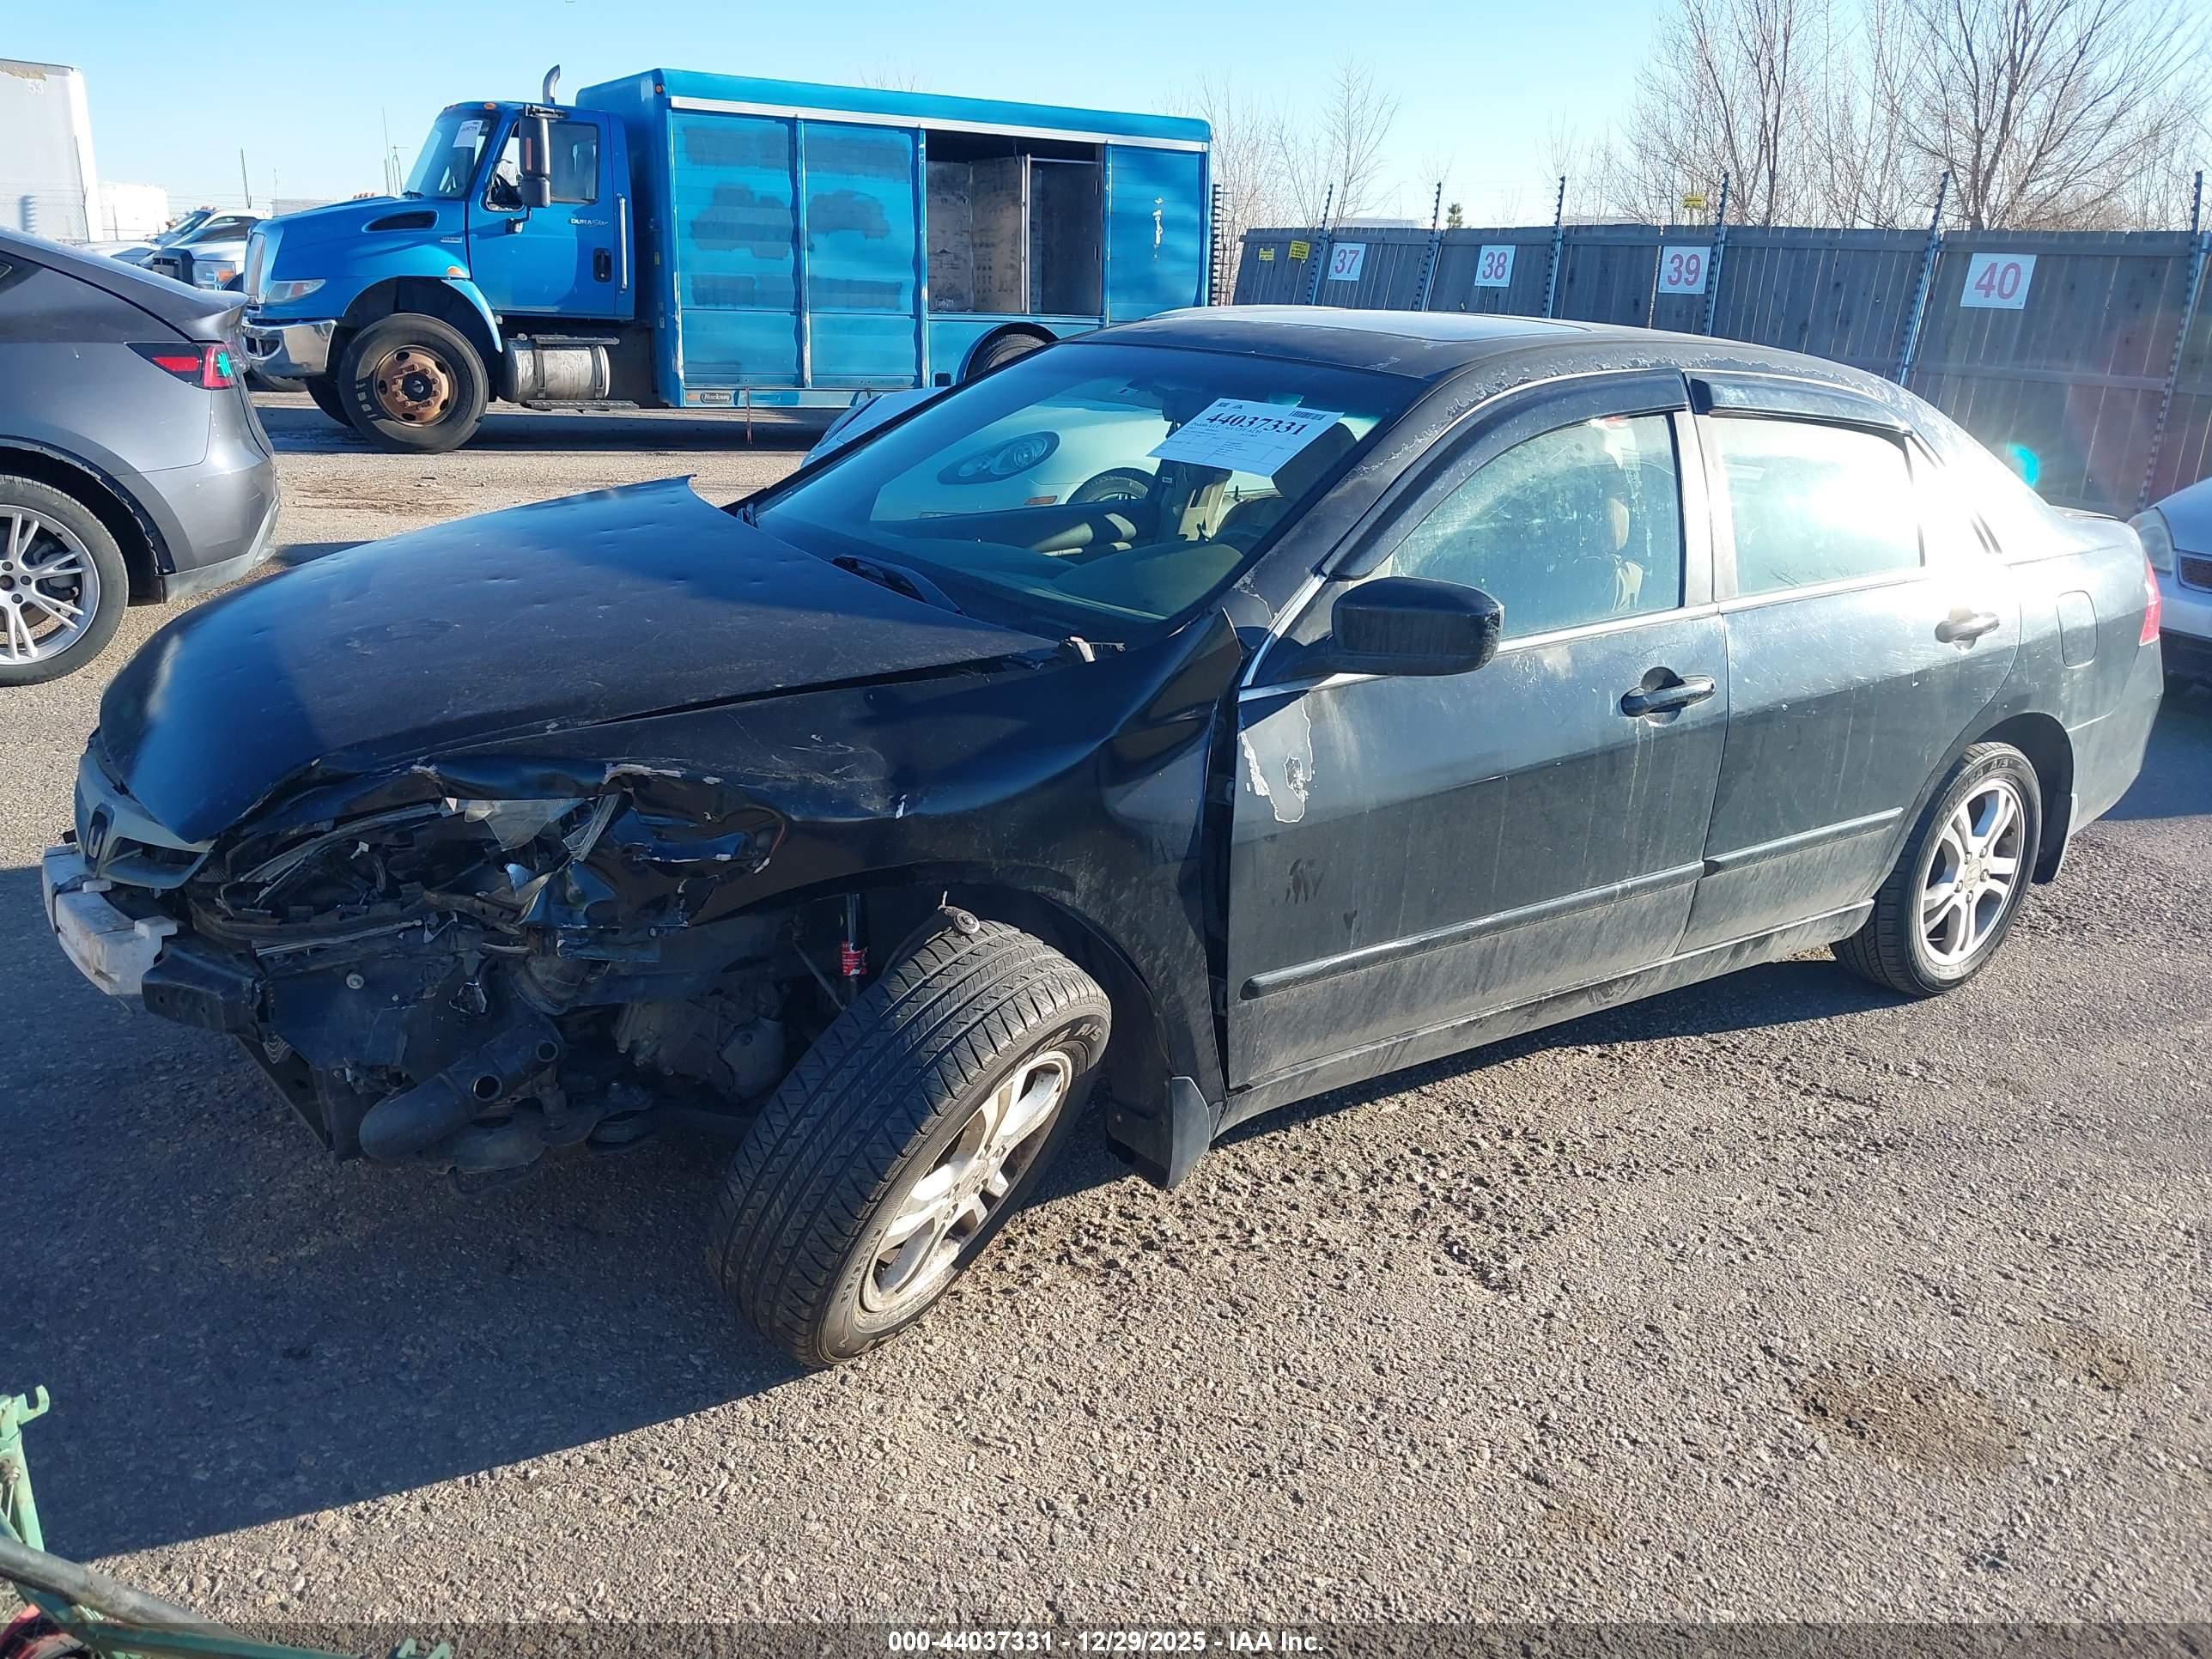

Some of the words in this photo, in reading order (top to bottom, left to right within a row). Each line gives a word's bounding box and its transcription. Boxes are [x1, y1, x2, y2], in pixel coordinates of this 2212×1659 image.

[1334, 249, 1360, 275] 37
[1482, 252, 1508, 281] 38
[1667, 254, 1701, 286] 39
[1975, 262, 2021, 300] 40
[1206, 412, 1308, 435] 44037331
[1074, 1023, 1103, 1042] A/S
